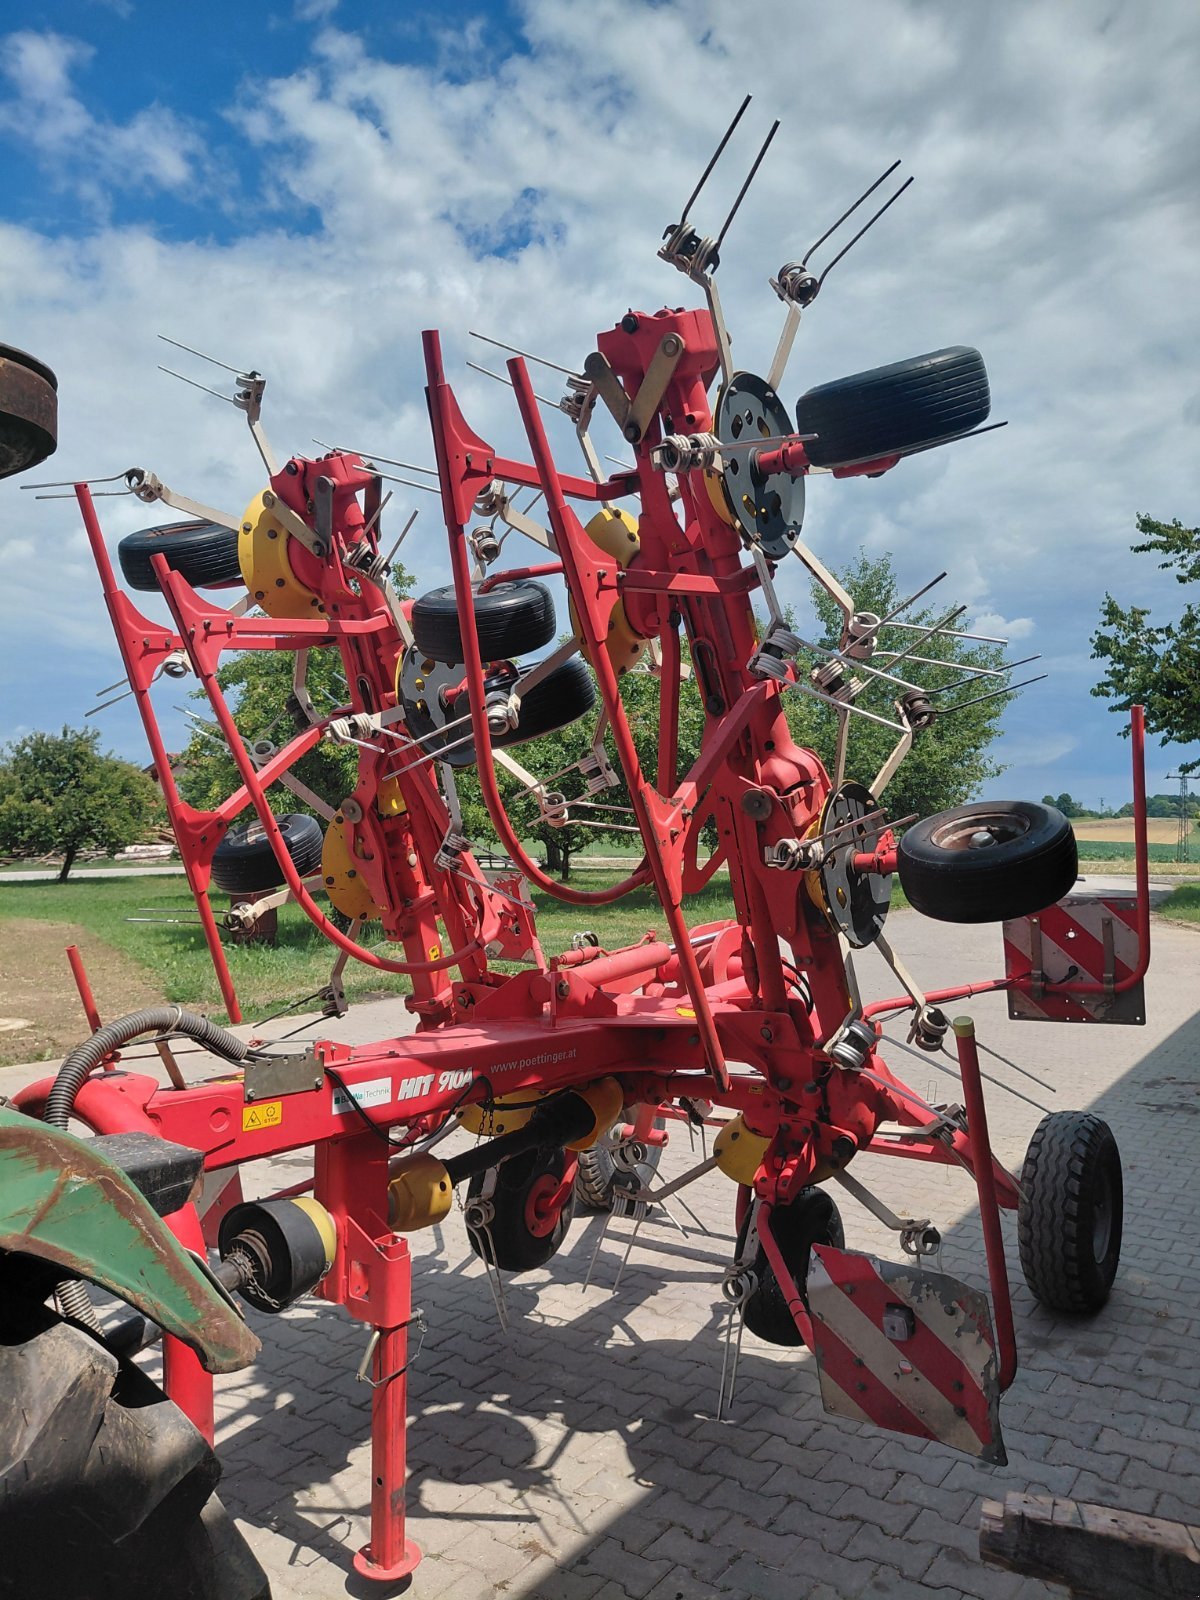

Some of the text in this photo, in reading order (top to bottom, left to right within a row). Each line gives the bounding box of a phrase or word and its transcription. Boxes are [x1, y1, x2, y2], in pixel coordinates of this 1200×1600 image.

[490, 1048, 577, 1073] www.poettinger.at
[397, 1066, 473, 1101] HIT 910A
[341, 1086, 390, 1104] BaWa Technik
[263, 1116, 279, 1124] STOP
